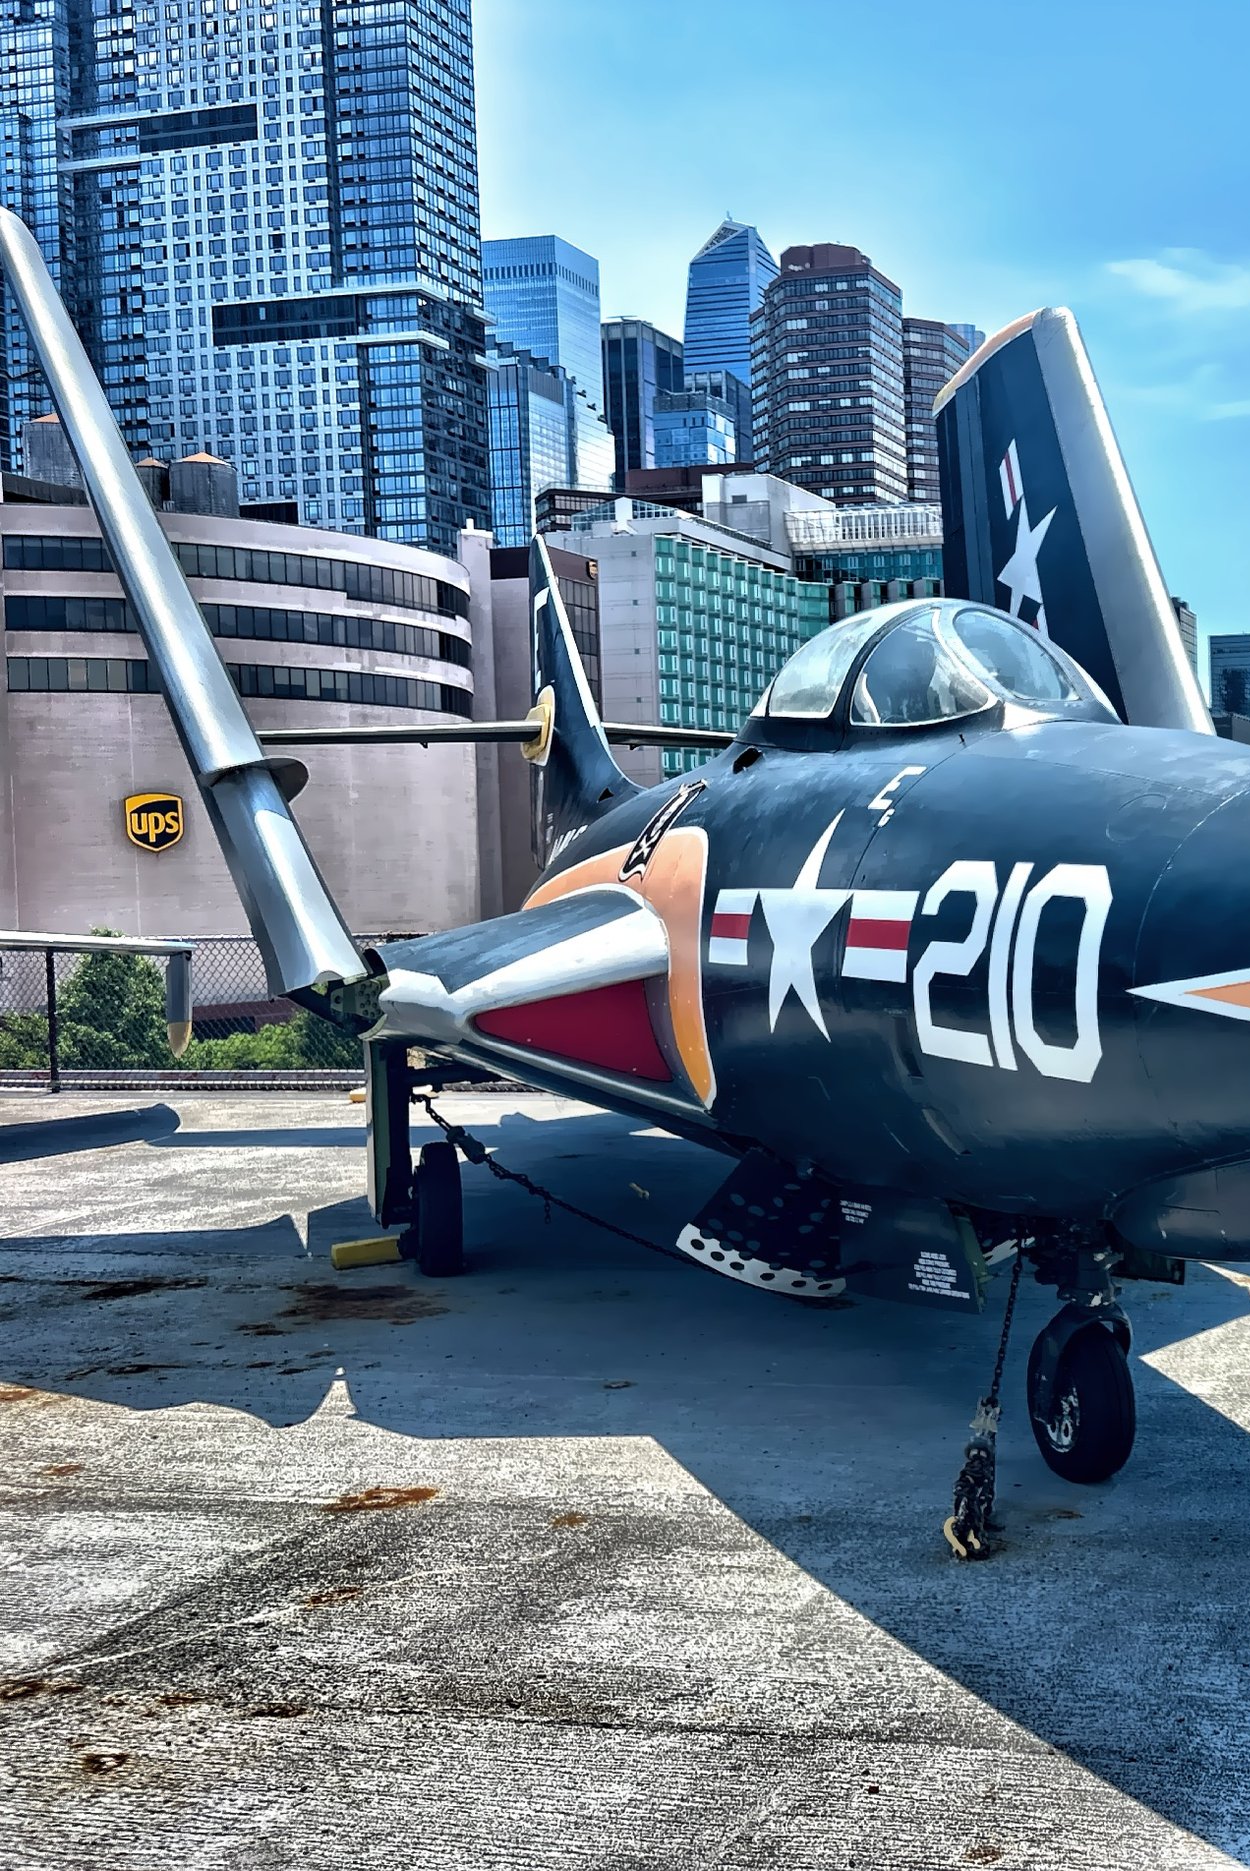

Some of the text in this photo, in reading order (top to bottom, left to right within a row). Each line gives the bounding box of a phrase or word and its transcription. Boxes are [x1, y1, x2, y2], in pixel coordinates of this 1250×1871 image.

[868, 766, 928, 810] E
[131, 811, 179, 843] ups
[913, 860, 1113, 1083] 210
